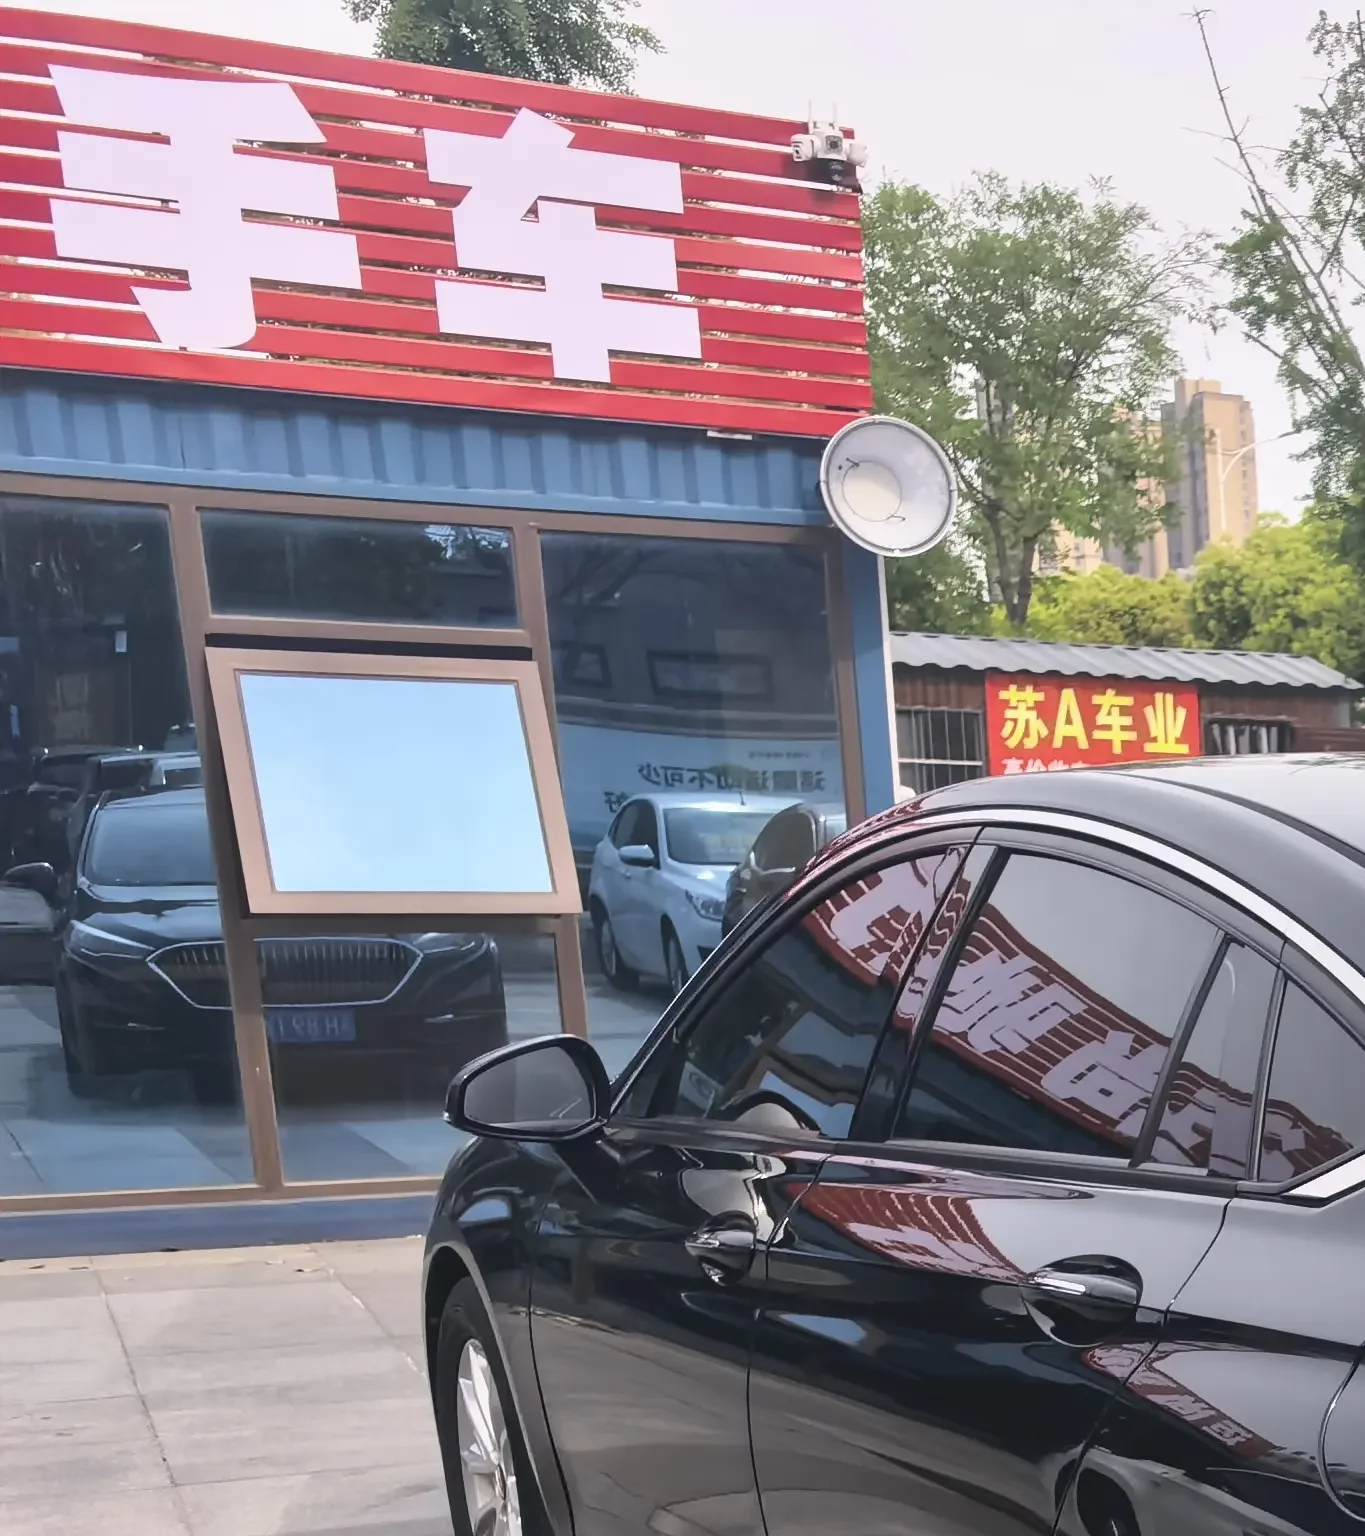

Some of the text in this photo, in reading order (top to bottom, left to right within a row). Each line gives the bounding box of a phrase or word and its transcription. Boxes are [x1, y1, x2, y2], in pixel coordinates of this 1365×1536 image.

[48, 64, 702, 383] 手车
[998, 683, 1190, 755] 苏A车业
